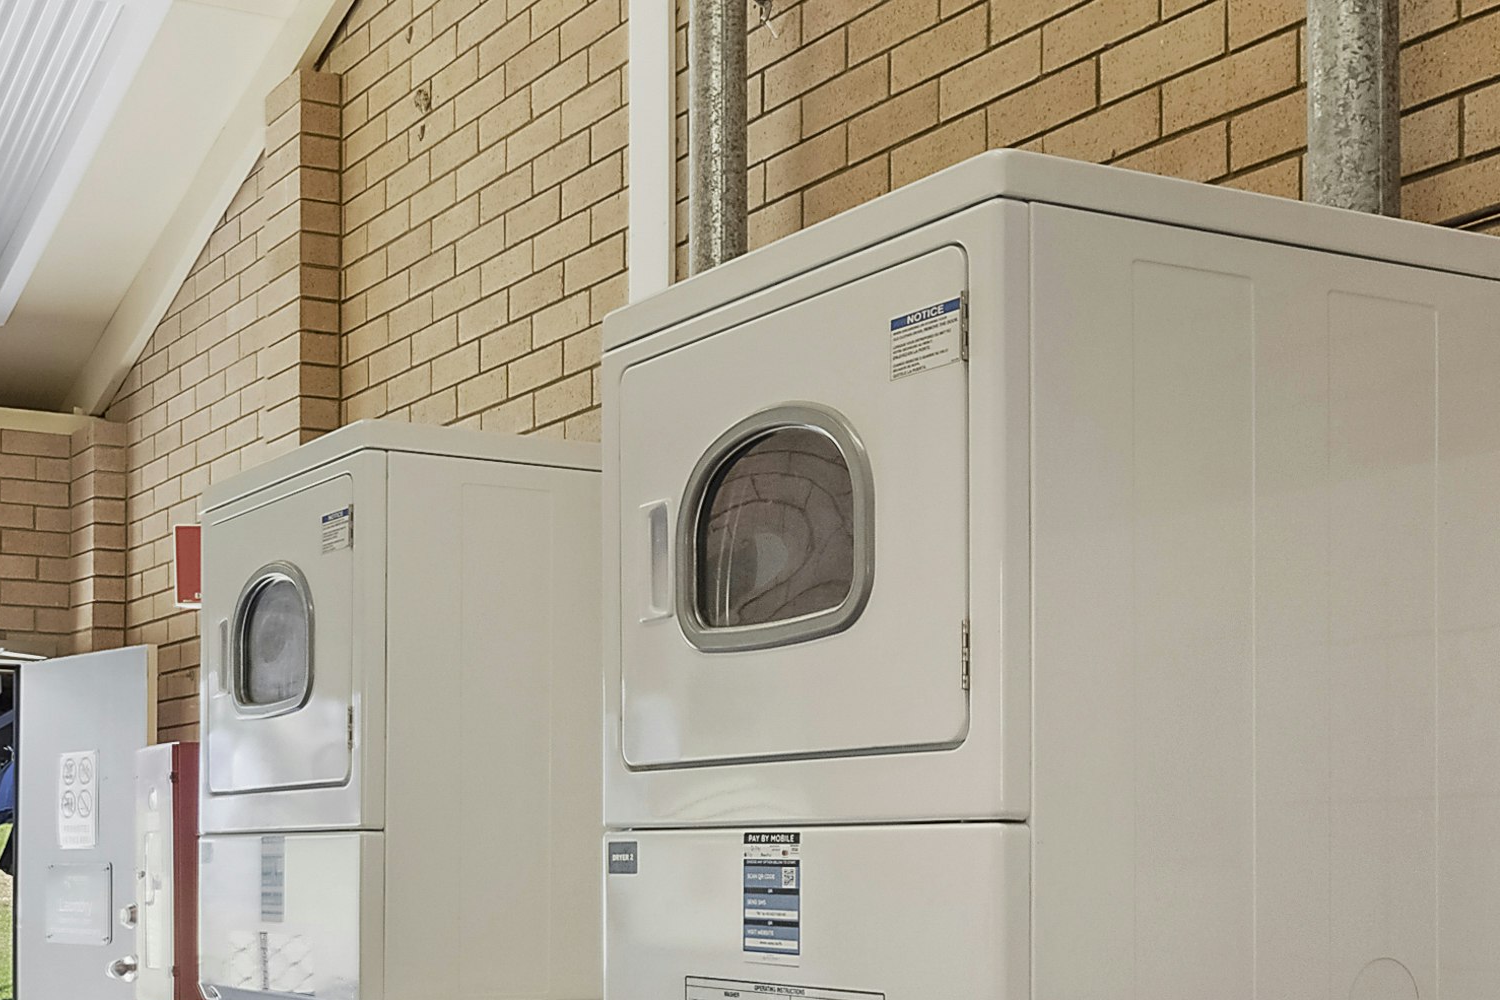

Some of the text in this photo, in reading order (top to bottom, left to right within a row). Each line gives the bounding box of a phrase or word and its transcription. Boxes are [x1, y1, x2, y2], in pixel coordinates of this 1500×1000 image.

[906, 304, 945, 325] NOTICE
[748, 834, 795, 843] PAY BY MOBILE
